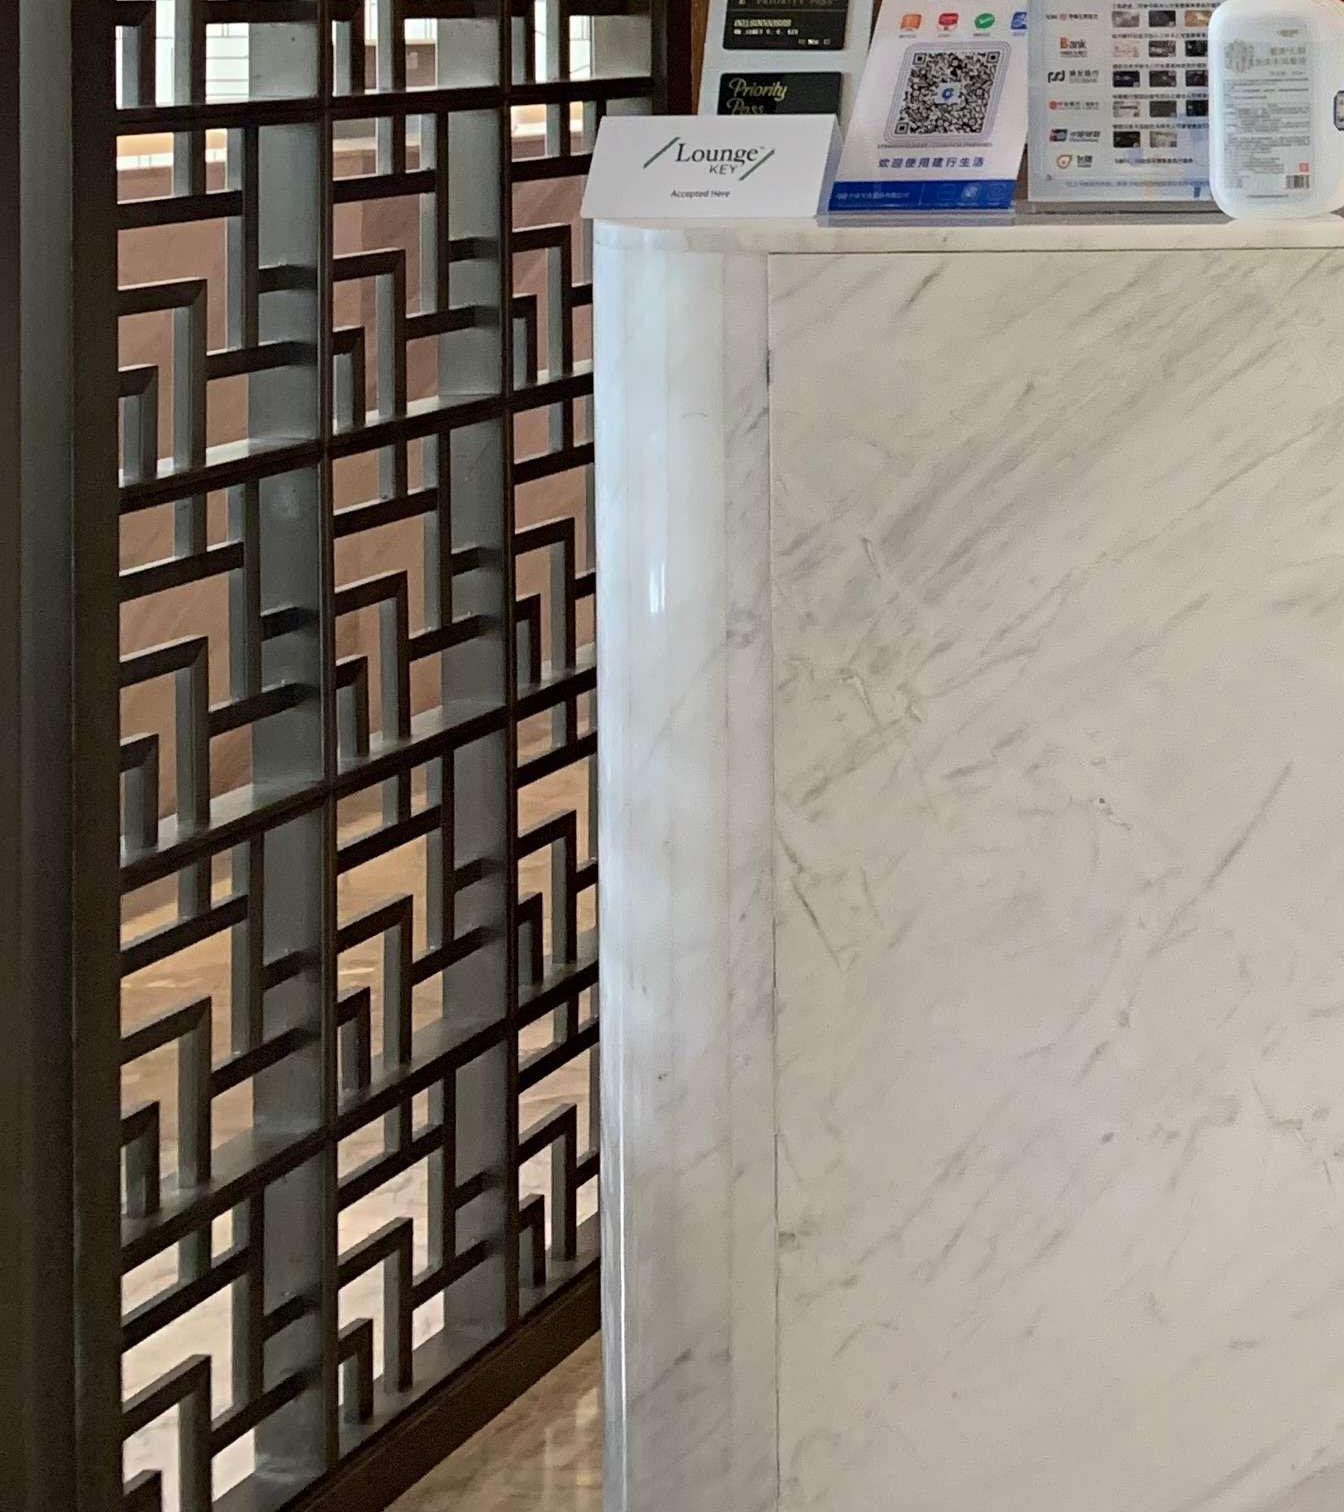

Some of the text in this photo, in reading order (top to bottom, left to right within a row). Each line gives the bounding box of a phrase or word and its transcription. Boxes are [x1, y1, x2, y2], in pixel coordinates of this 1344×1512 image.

[728, 77, 788, 102] Priority
[726, 97, 765, 115] Pass
[675, 142, 759, 165] Lounge
[708, 164, 738, 175] KEY
[878, 156, 984, 168] 欢迎使用建行生活
[670, 189, 731, 199] Accepted Here
